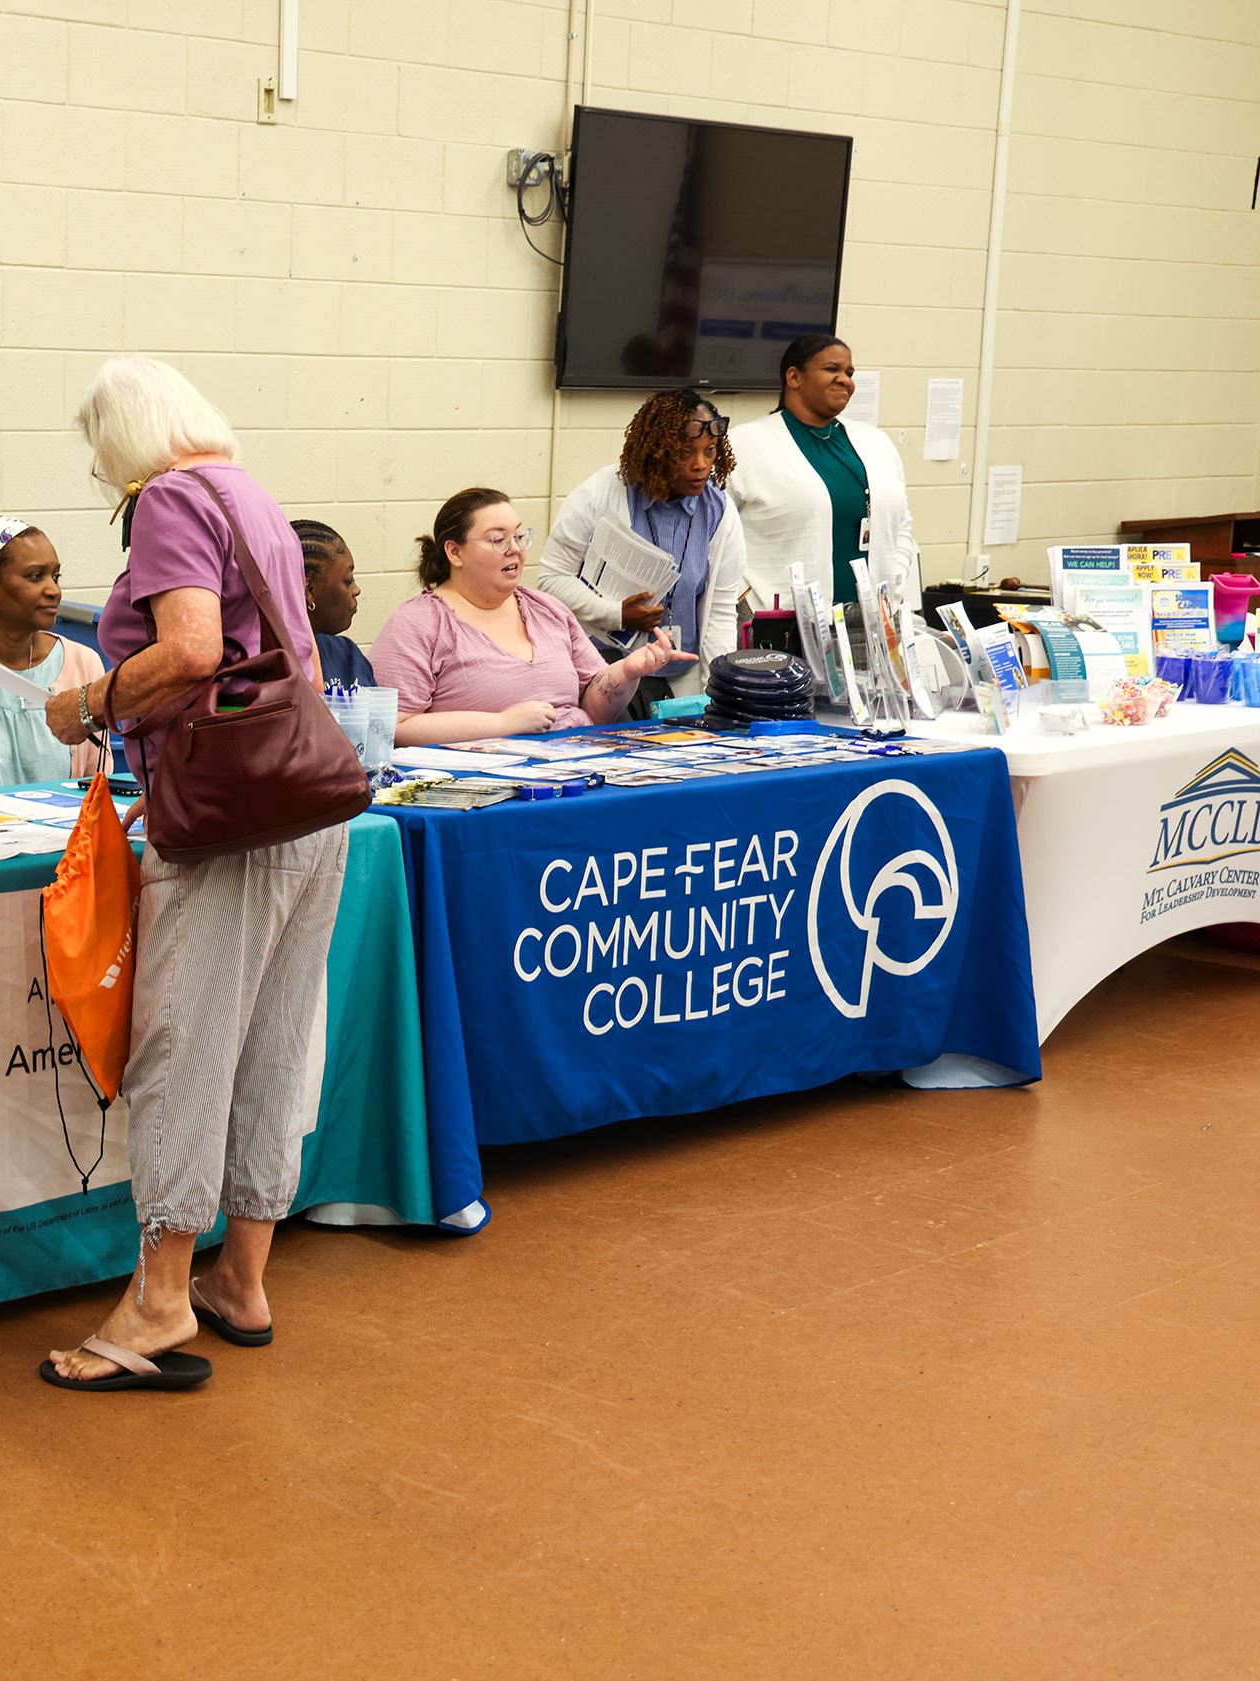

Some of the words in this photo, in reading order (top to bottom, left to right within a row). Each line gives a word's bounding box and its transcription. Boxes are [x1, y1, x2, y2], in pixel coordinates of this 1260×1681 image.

[1079, 560, 1095, 568] CAN
[1096, 560, 1116, 568] HELP!
[1152, 550, 1172, 560] PRE
[1162, 569, 1182, 579] PRE
[540, 846, 669, 914] CAPE
[675, 829, 800, 896] FEAR
[513, 889, 796, 983] COMMUNITY
[583, 950, 790, 1036] COLLEGE
[3, 1226, 12, 1235] of
[12, 1225, 25, 1233] the
[26, 1222, 38, 1231] US
[73, 1209, 81, 1218] of
[81, 1205, 99, 1216] Labor
[101, 1204, 108, 1212] as
